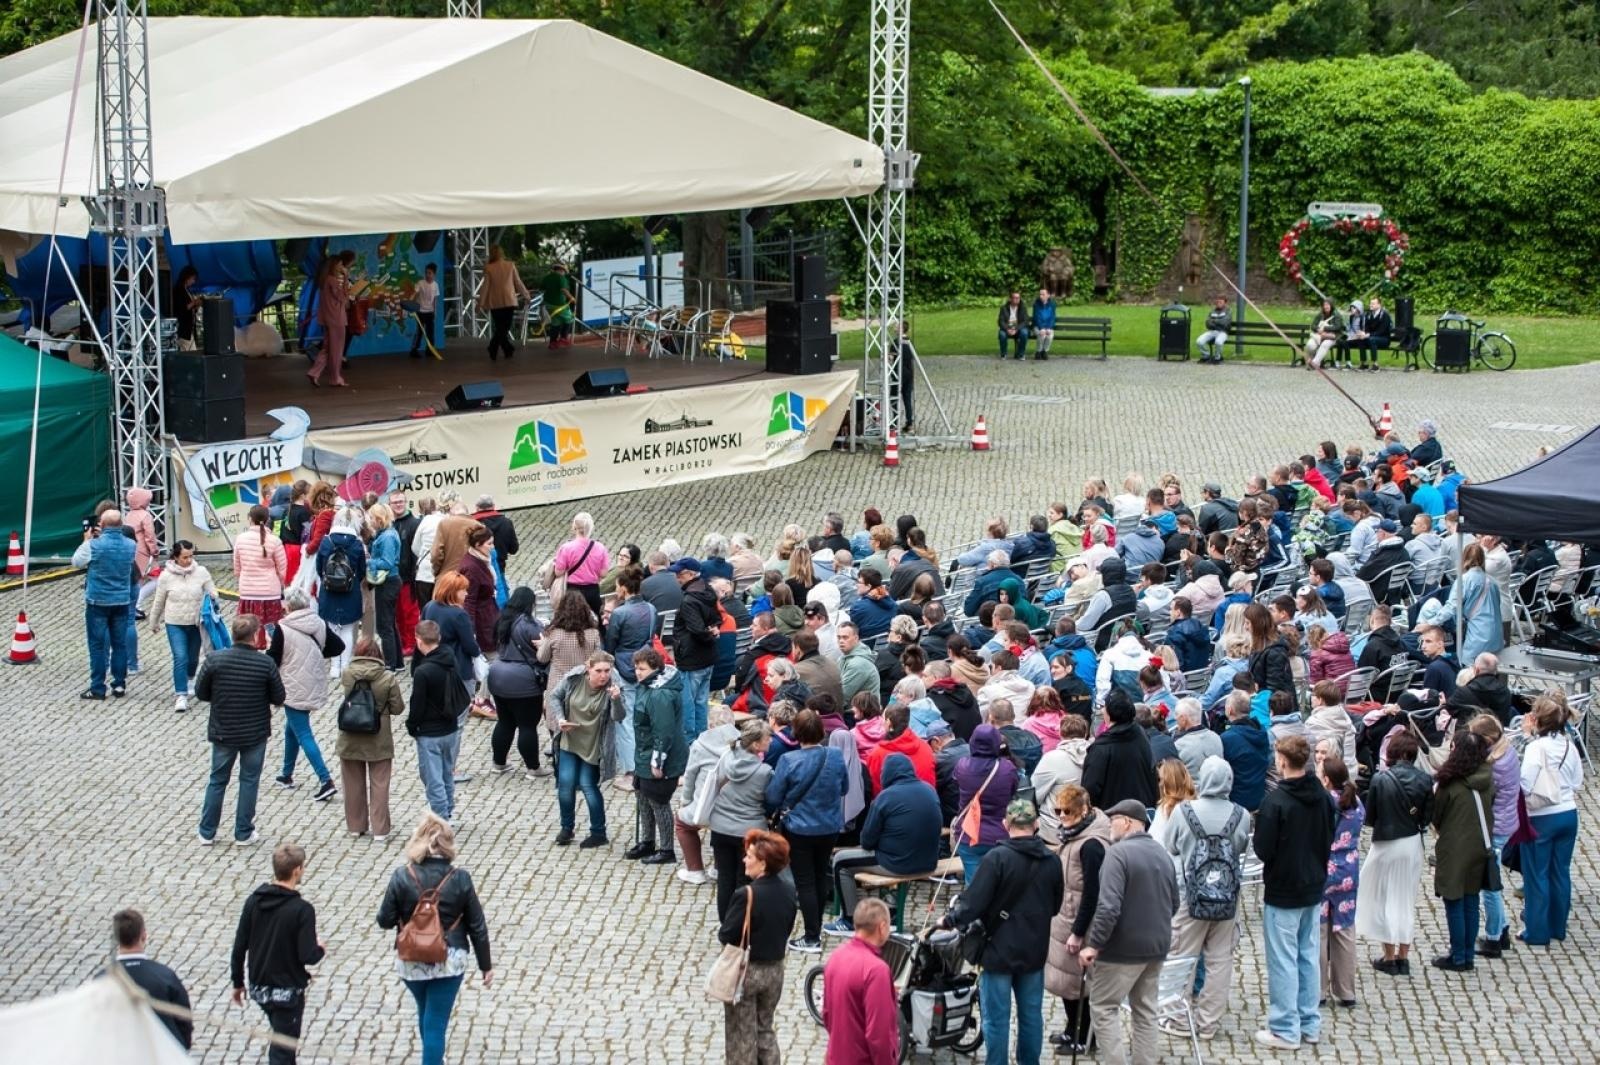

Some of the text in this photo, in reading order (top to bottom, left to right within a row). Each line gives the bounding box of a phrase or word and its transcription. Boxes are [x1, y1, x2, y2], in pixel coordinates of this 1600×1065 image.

[613, 432, 742, 465] ZAMEK PIASTOWSKI
[201, 444, 284, 483] WŁOCHY
[655, 459, 713, 474] RACIBORZU
[397, 466, 480, 493] ASTOWSKI
[507, 471, 541, 488] powiat
